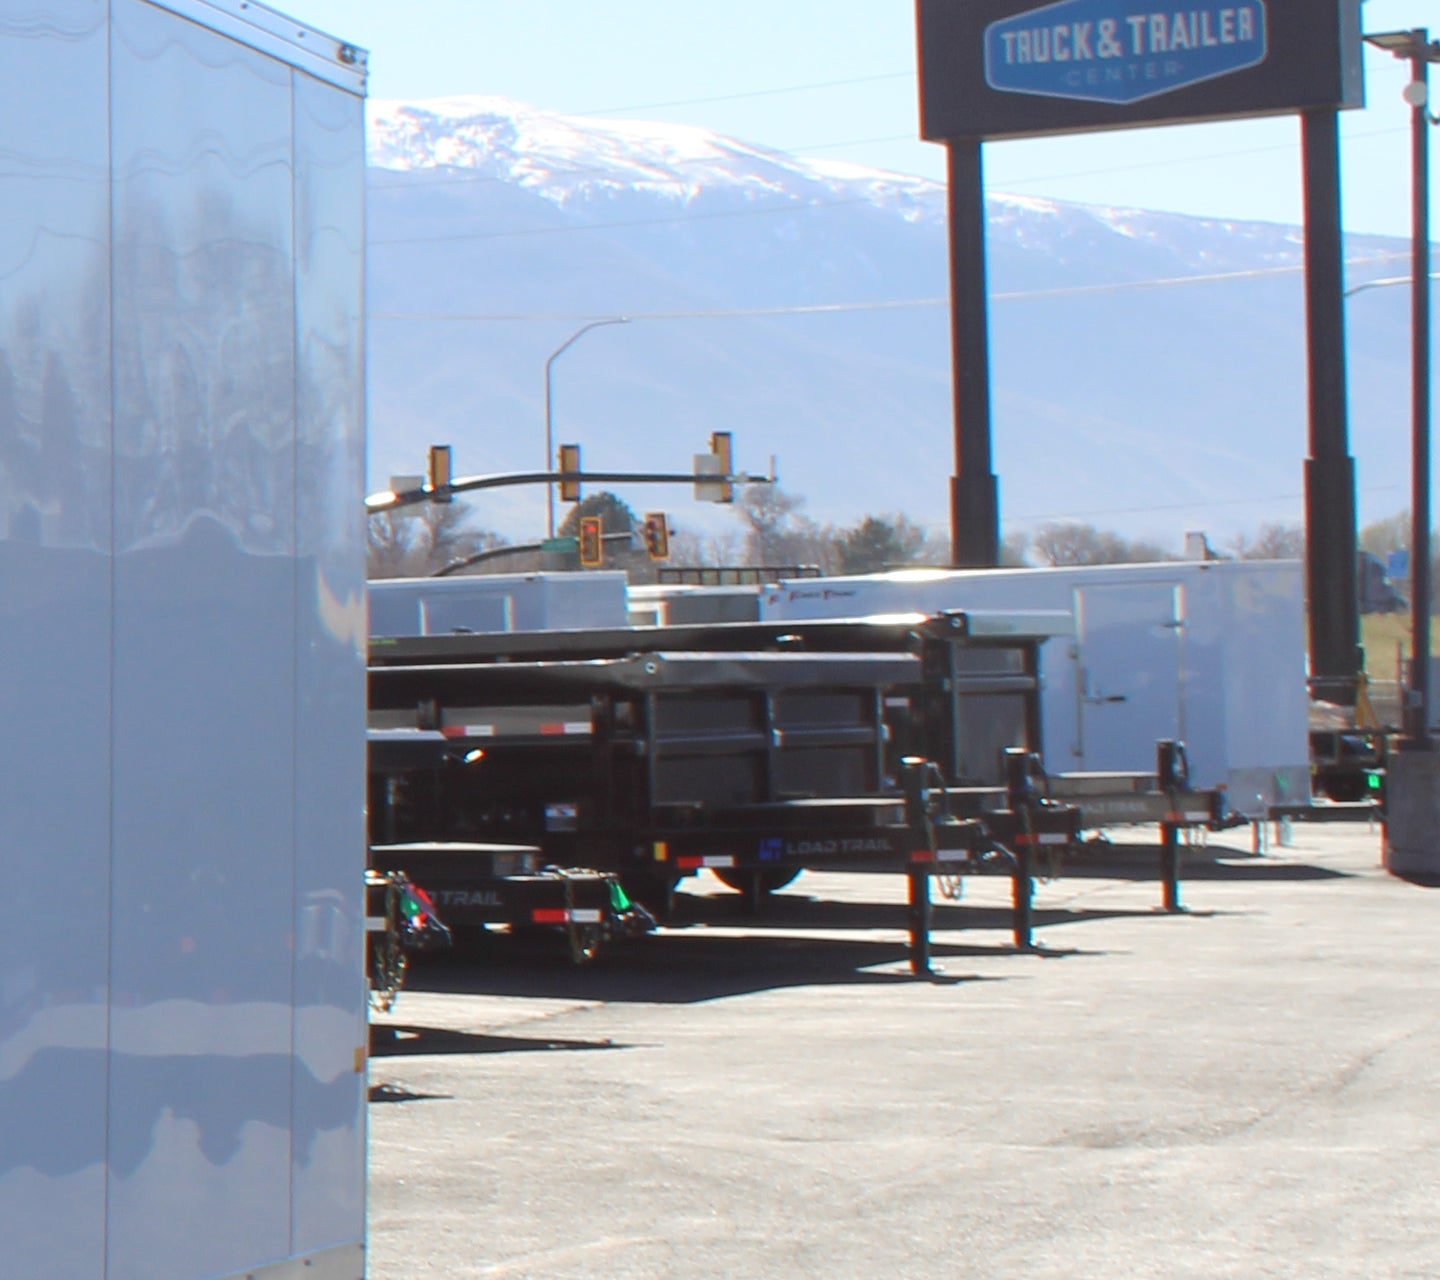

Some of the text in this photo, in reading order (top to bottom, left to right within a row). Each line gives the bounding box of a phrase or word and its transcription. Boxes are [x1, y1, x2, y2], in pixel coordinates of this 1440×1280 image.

[1000, 6, 1254, 65] TRUCK & TRAILER
[1065, 60, 1178, 87] CENTER
[786, 840, 836, 855] LOAD
[838, 837, 893, 853] TRAIL
[440, 889, 503, 906] TRAIL
